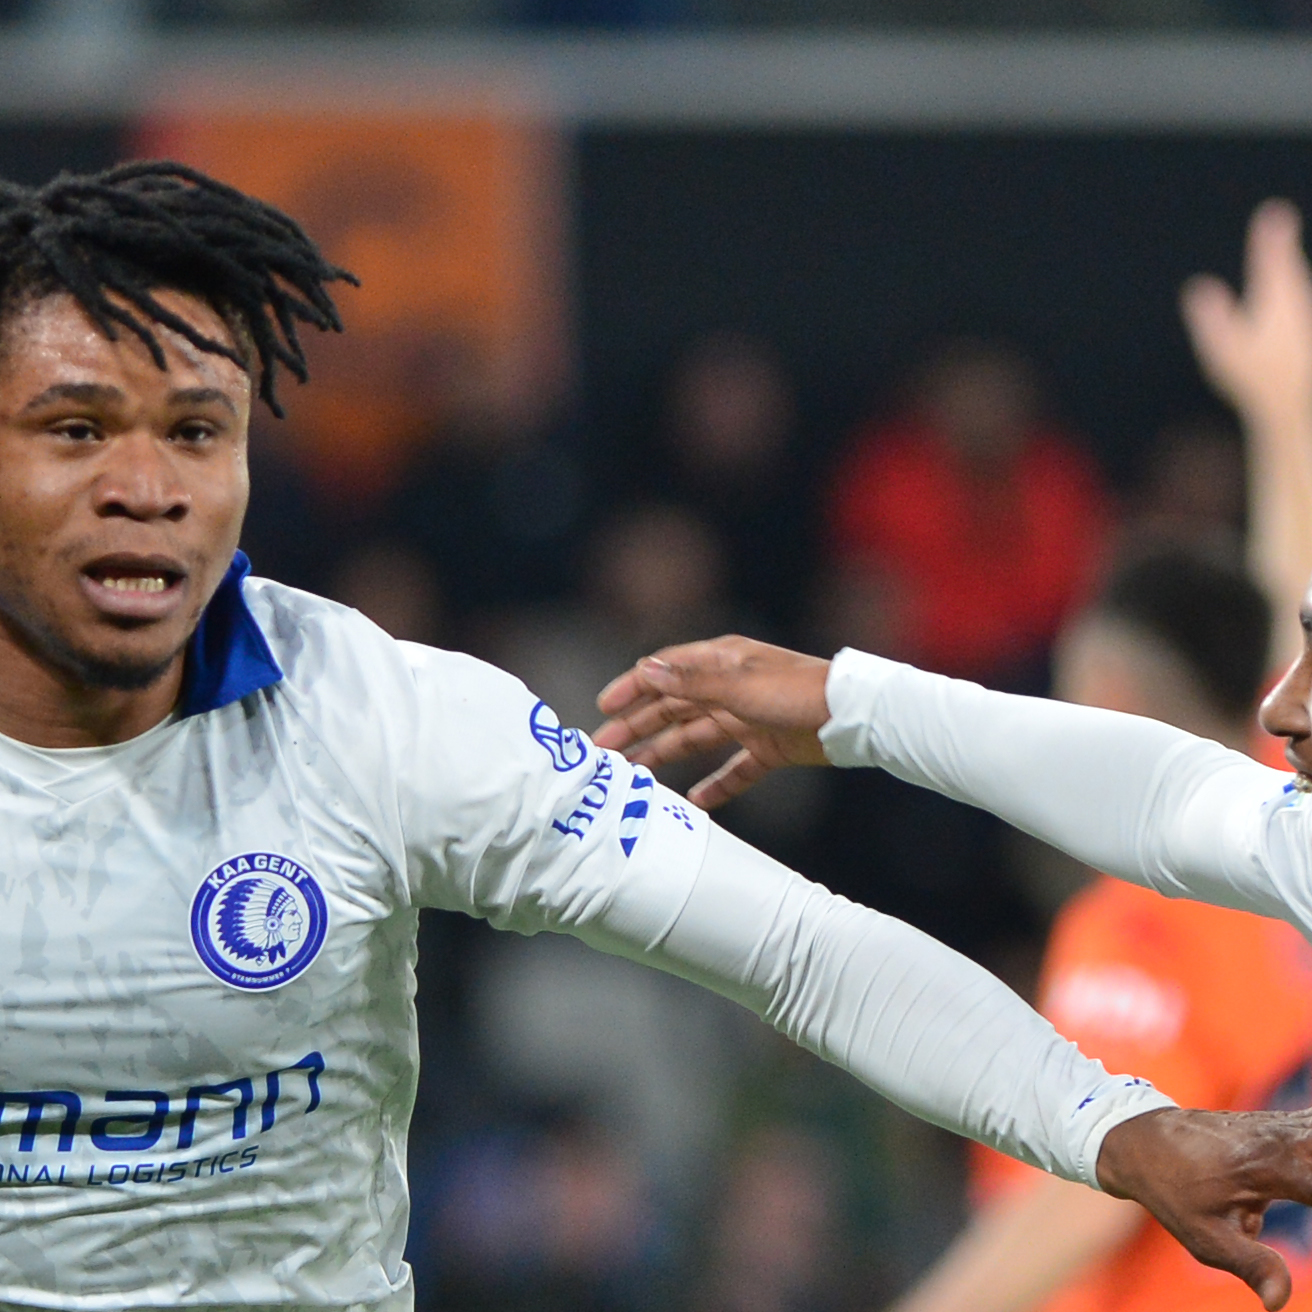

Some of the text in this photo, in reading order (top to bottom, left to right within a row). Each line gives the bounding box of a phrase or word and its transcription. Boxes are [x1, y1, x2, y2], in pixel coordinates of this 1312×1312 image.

[207, 855, 308, 890] KAA GENT
[87, 1144, 259, 1187] LOGISTICS
